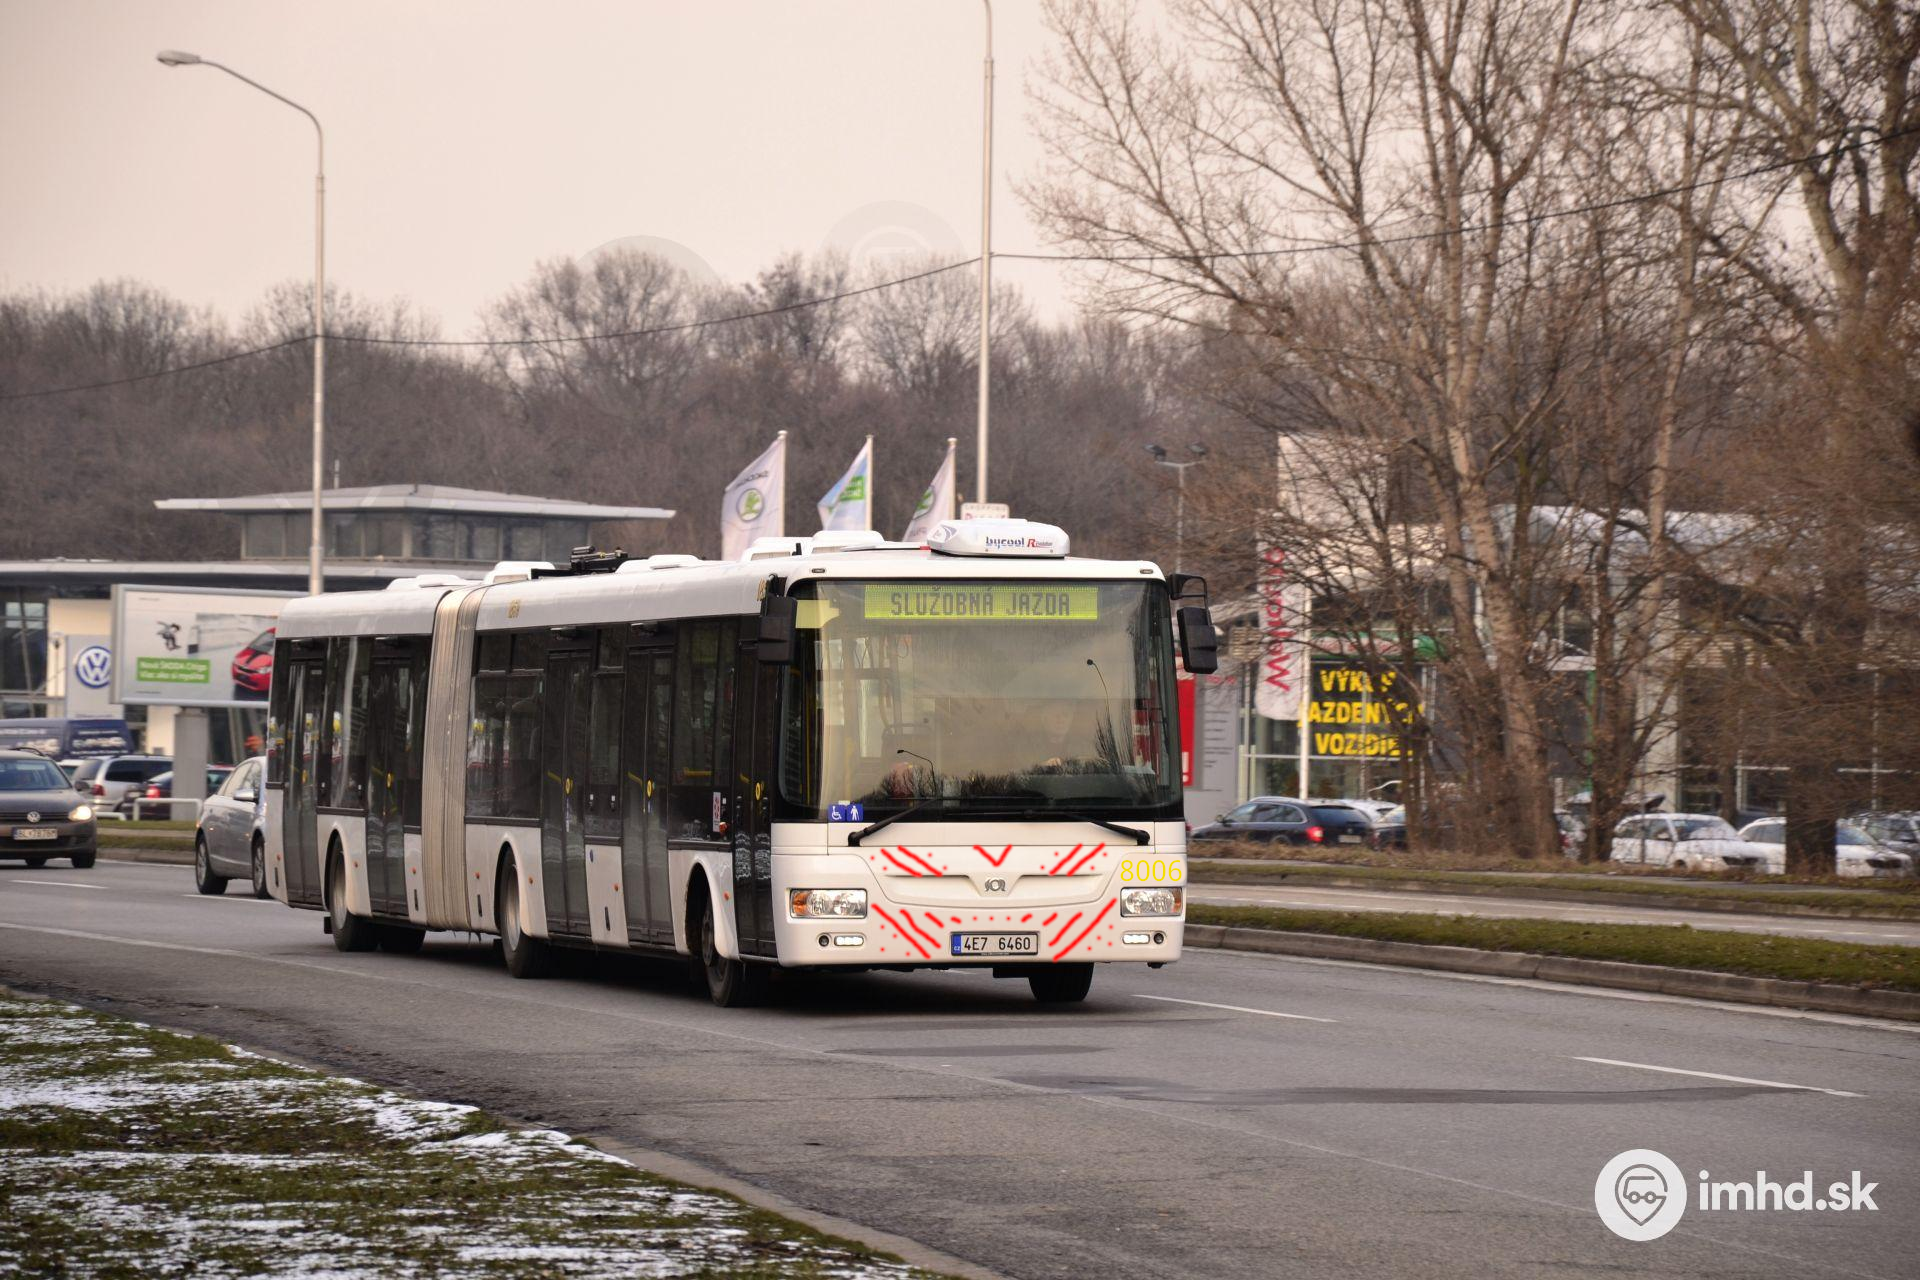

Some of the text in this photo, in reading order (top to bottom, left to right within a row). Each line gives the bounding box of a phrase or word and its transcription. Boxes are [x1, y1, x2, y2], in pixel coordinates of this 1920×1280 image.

[890, 585, 1070, 616] SLUŽOBNÁ JAZDA
[1120, 859, 1182, 882] 8006
[964, 936, 988, 951] 4E7
[998, 936, 1031, 951] 6460
